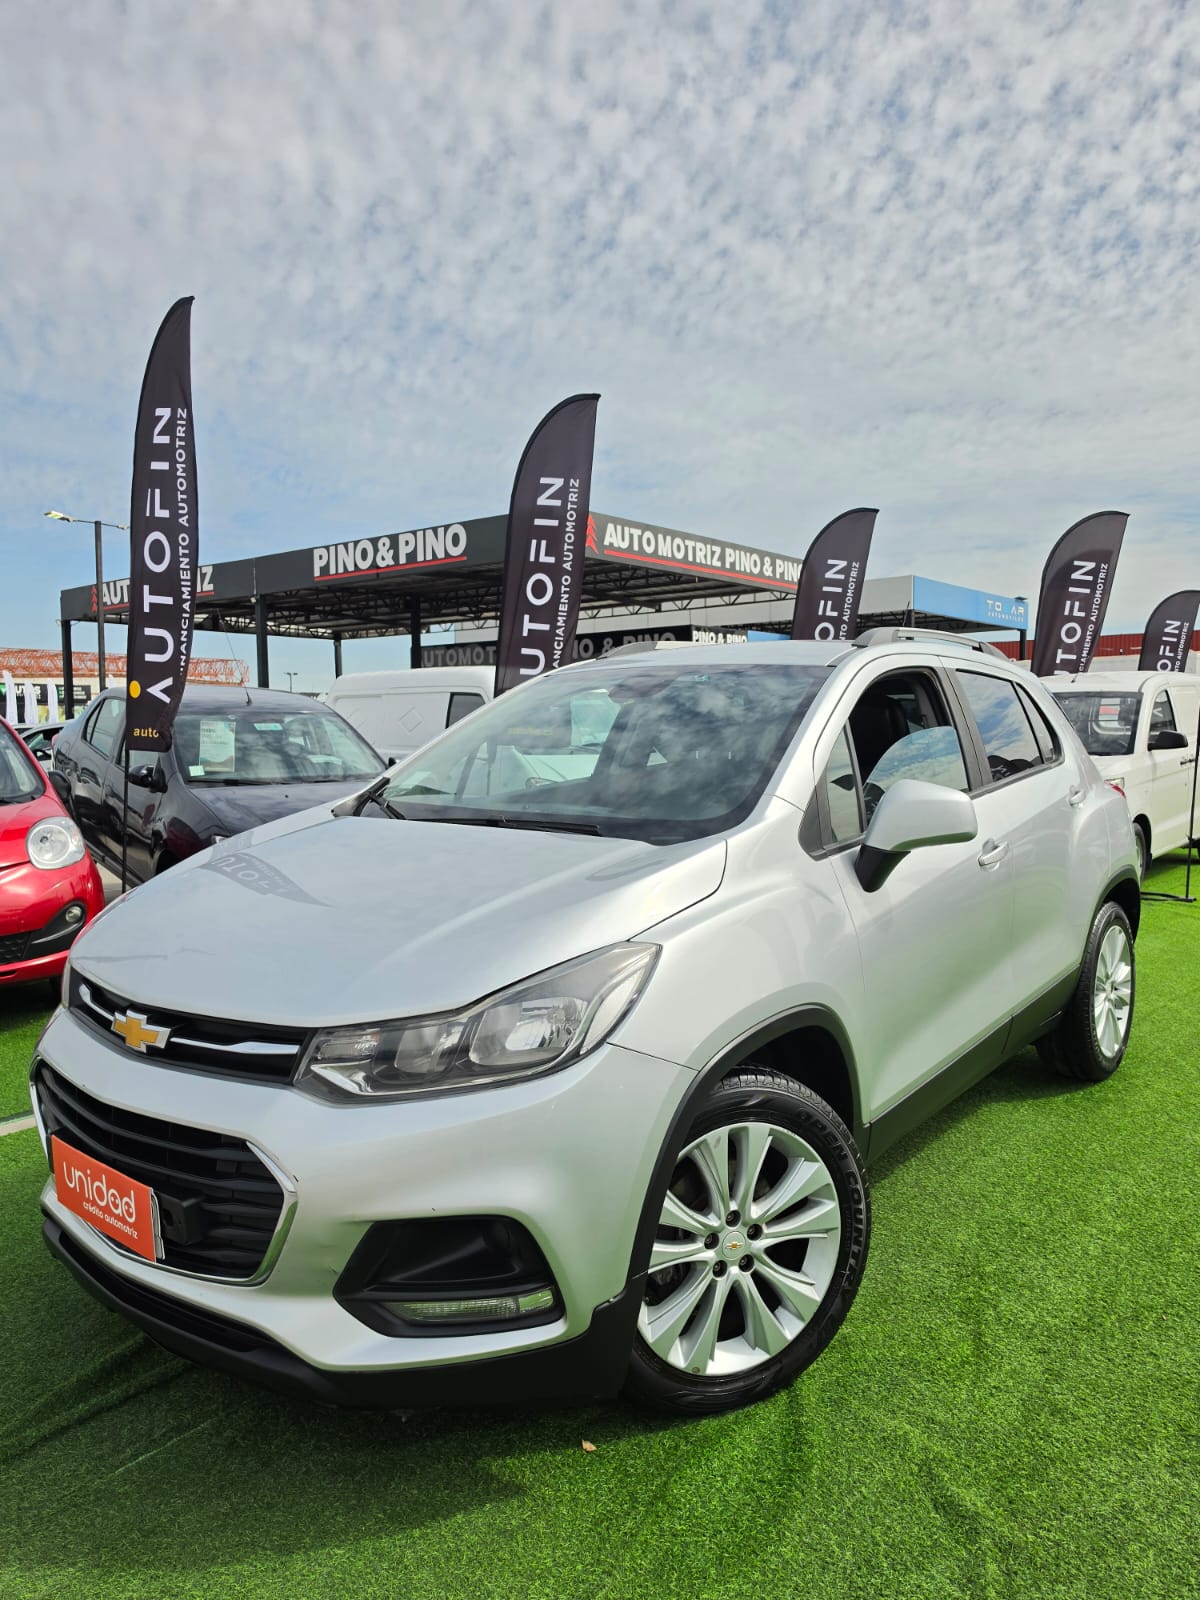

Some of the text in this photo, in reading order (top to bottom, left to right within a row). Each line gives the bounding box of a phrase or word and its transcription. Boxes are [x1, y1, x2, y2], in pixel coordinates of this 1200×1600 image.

[176, 407, 191, 676] NANCIAMIENTO AUTOMOTRIZ
[313, 523, 467, 577] PINO & PINO
[562, 477, 580, 571] AUTOMOTRIZ
[143, 407, 174, 704] AUTOFIN
[725, 547, 761, 575] PINO
[763, 556, 774, 577] &
[842, 561, 860, 622] AUTOMOTRIZ
[1090, 563, 1108, 622] AUTOMOTRIZ
[63, 1161, 136, 1223] unidad
[104, 1213, 138, 1239] automotriz
